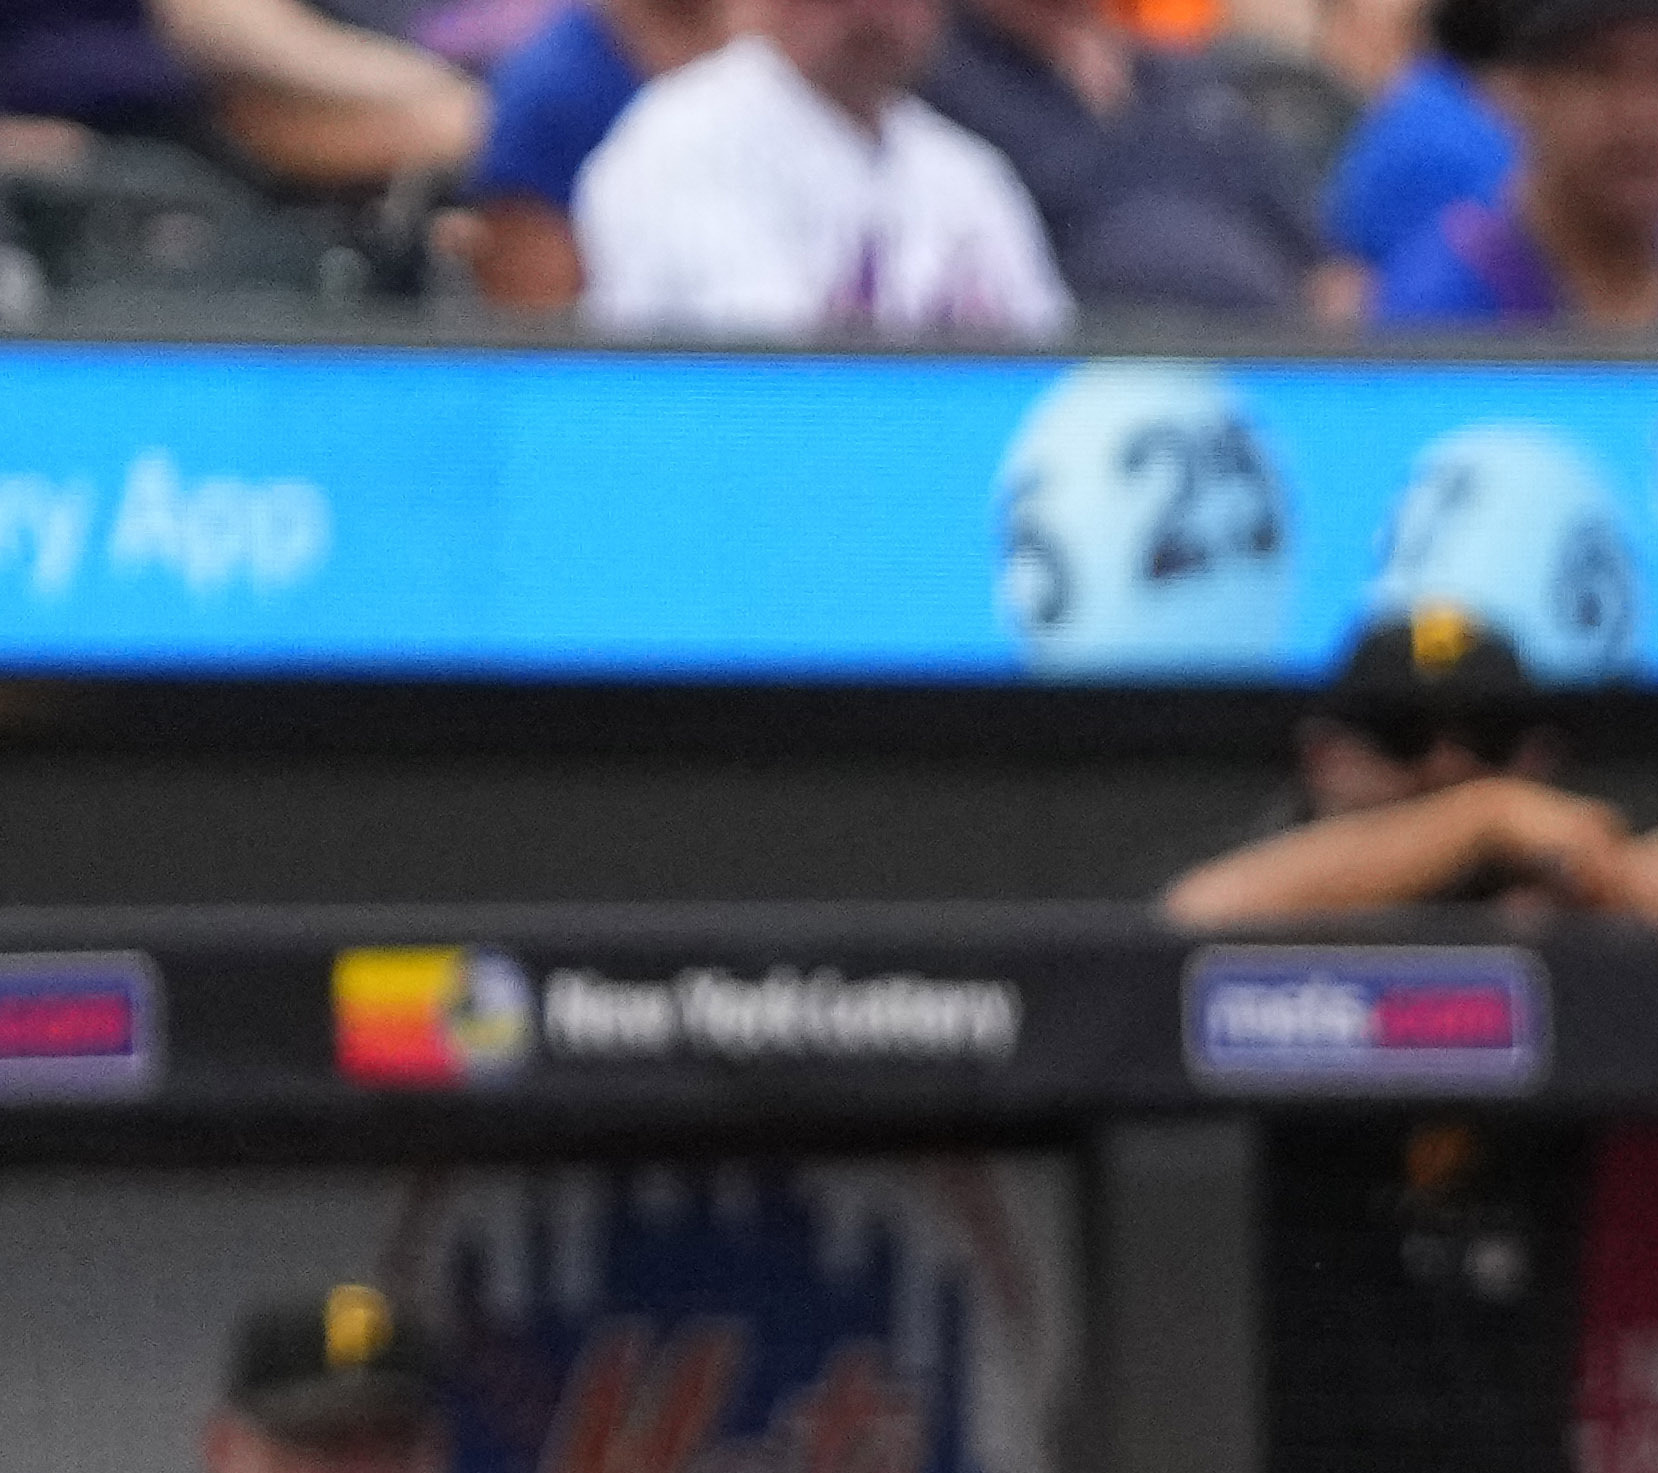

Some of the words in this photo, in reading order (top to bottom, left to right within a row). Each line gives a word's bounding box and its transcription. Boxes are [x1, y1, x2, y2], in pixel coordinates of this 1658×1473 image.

[112, 448, 330, 592] App
[547, 966, 672, 1056] New
[678, 966, 800, 1060] York
